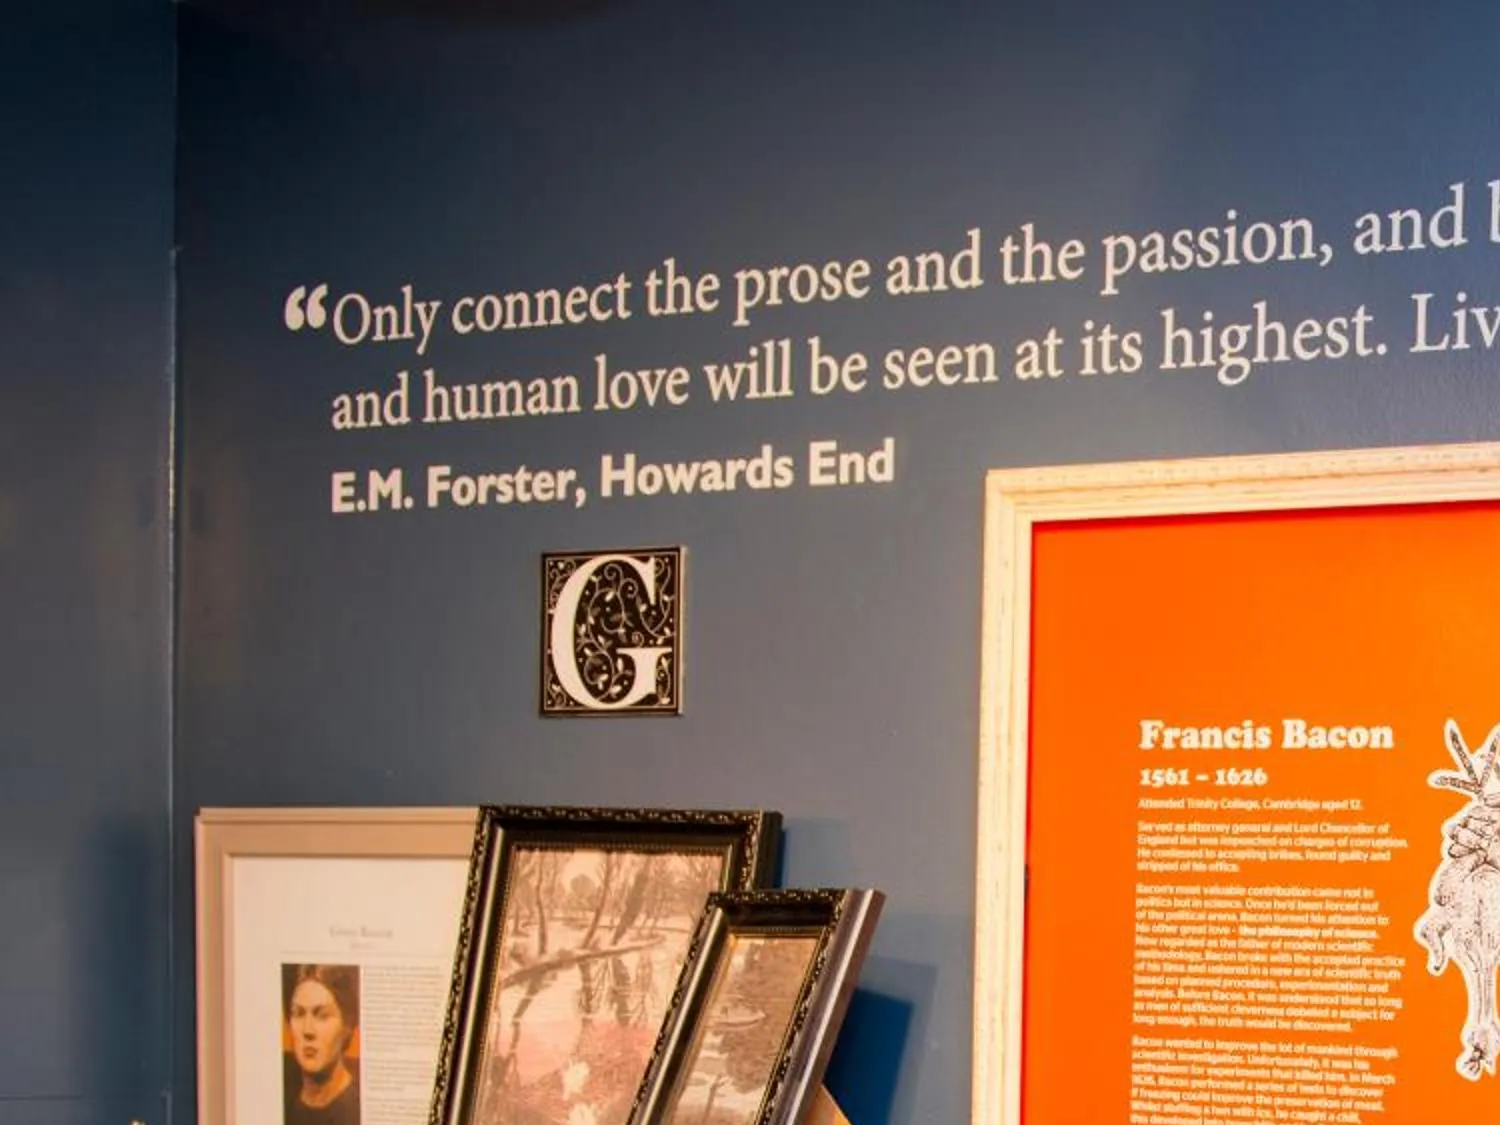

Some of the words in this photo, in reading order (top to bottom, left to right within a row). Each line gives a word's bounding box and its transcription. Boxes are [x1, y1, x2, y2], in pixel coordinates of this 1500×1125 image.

[452, 273, 632, 334] connect
[645, 258, 720, 316] the
[733, 260, 870, 326] prose
[887, 228, 983, 294] and
[1000, 224, 1084, 284] the
[1101, 209, 1332, 295] passion,
[1354, 182, 1468, 254] and
[332, 371, 411, 429] and
[423, 369, 580, 422] human
[594, 354, 689, 409] love
[704, 339, 792, 401] will
[808, 336, 867, 394] be
[884, 344, 997, 388] seen
[1016, 329, 1063, 379] at
[1080, 320, 1142, 374] its
[1160, 301, 1386, 385] highest.
[332, 469, 413, 512] E.M.
[428, 466, 585, 507] Forster,
[602, 445, 792, 496] Howards
[810, 438, 894, 485] End
[551, 555, 673, 709] G
[1139, 719, 1271, 750] Francis
[1282, 719, 1394, 749] Bacon
[1140, 768, 1190, 787] 1561
[1215, 768, 1268, 786] 1626
